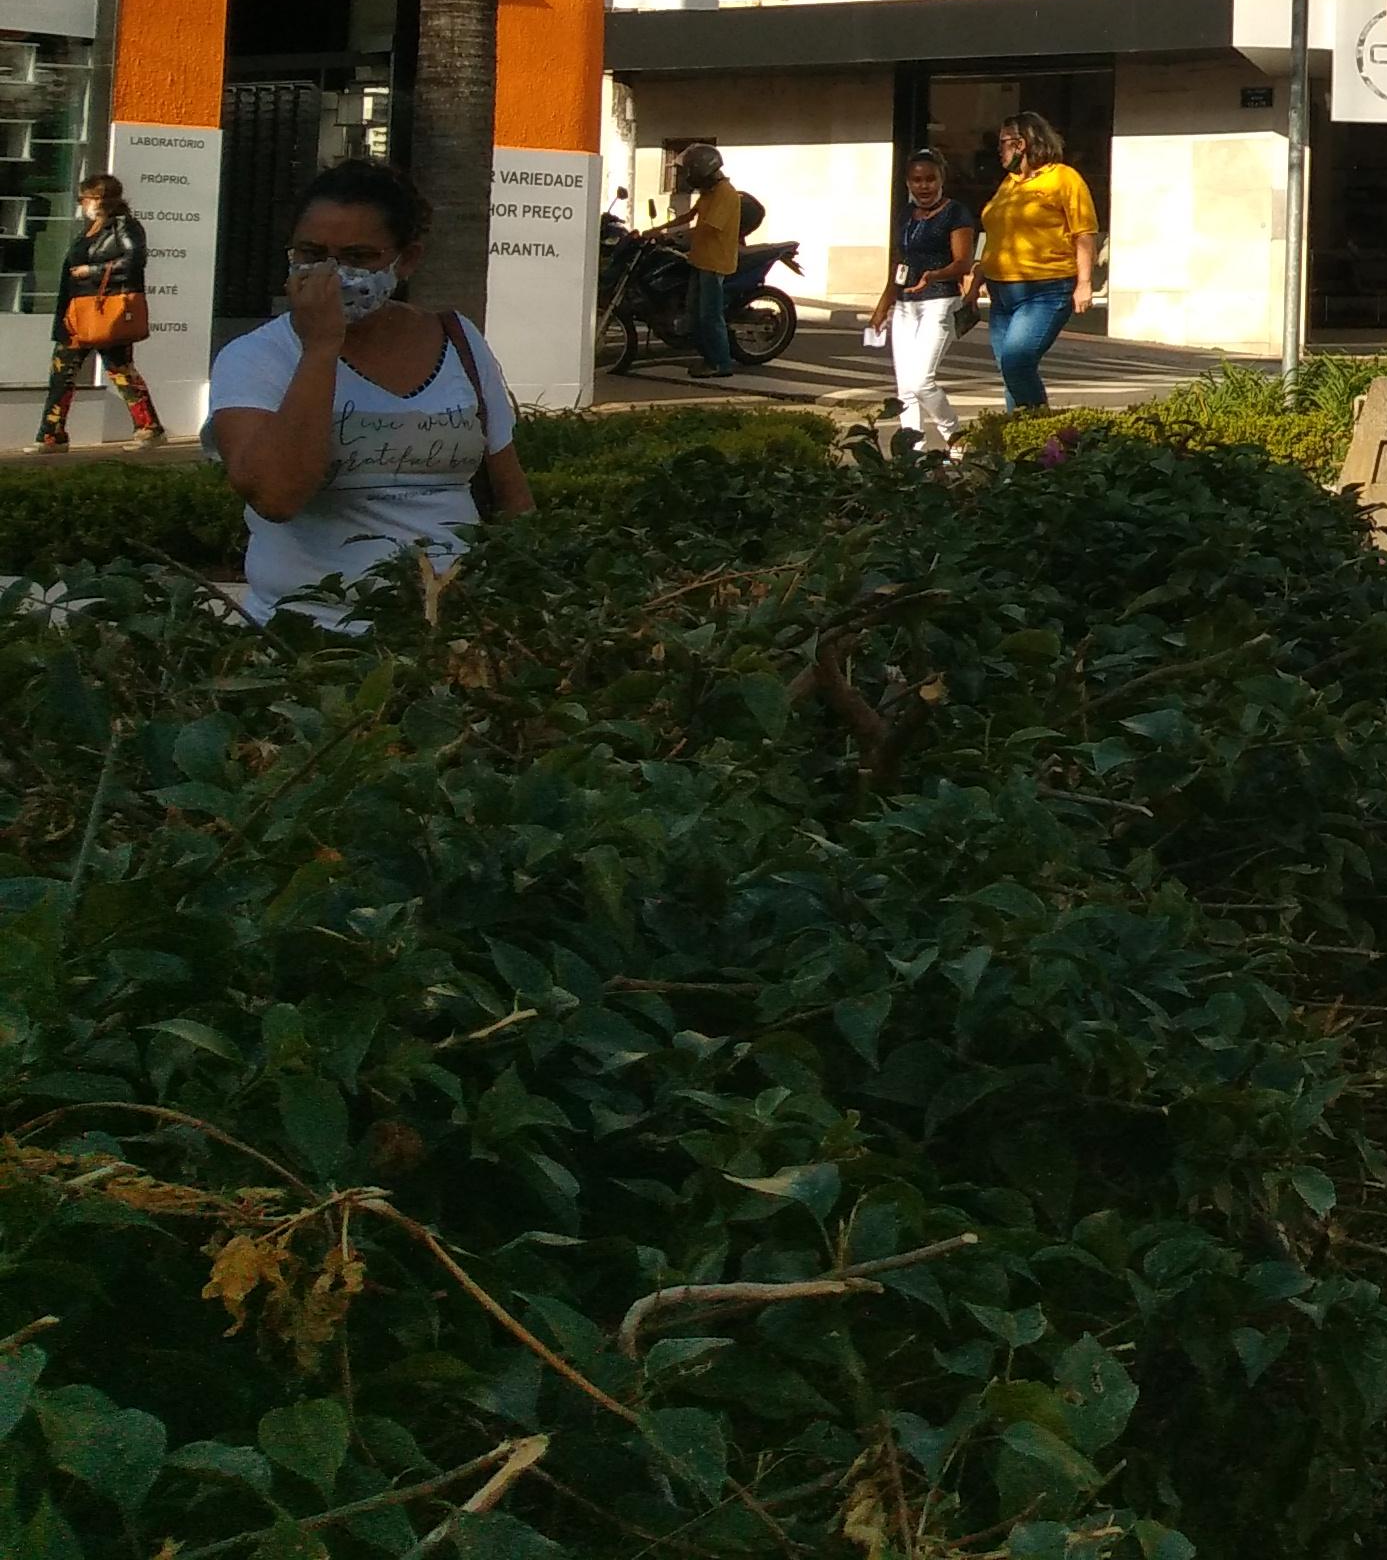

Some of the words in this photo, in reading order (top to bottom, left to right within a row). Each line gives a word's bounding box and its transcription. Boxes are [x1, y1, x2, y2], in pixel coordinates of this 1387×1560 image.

[130, 136, 204, 149] LABORATÓRIO
[500, 171, 583, 188] VARIEDADE
[157, 210, 200, 222] ÓCULOS
[488, 203, 517, 218] HOR
[522, 205, 573, 222] PREÇO
[489, 242, 560, 258] ARANTIA,
[158, 284, 178, 295] ATÉ
